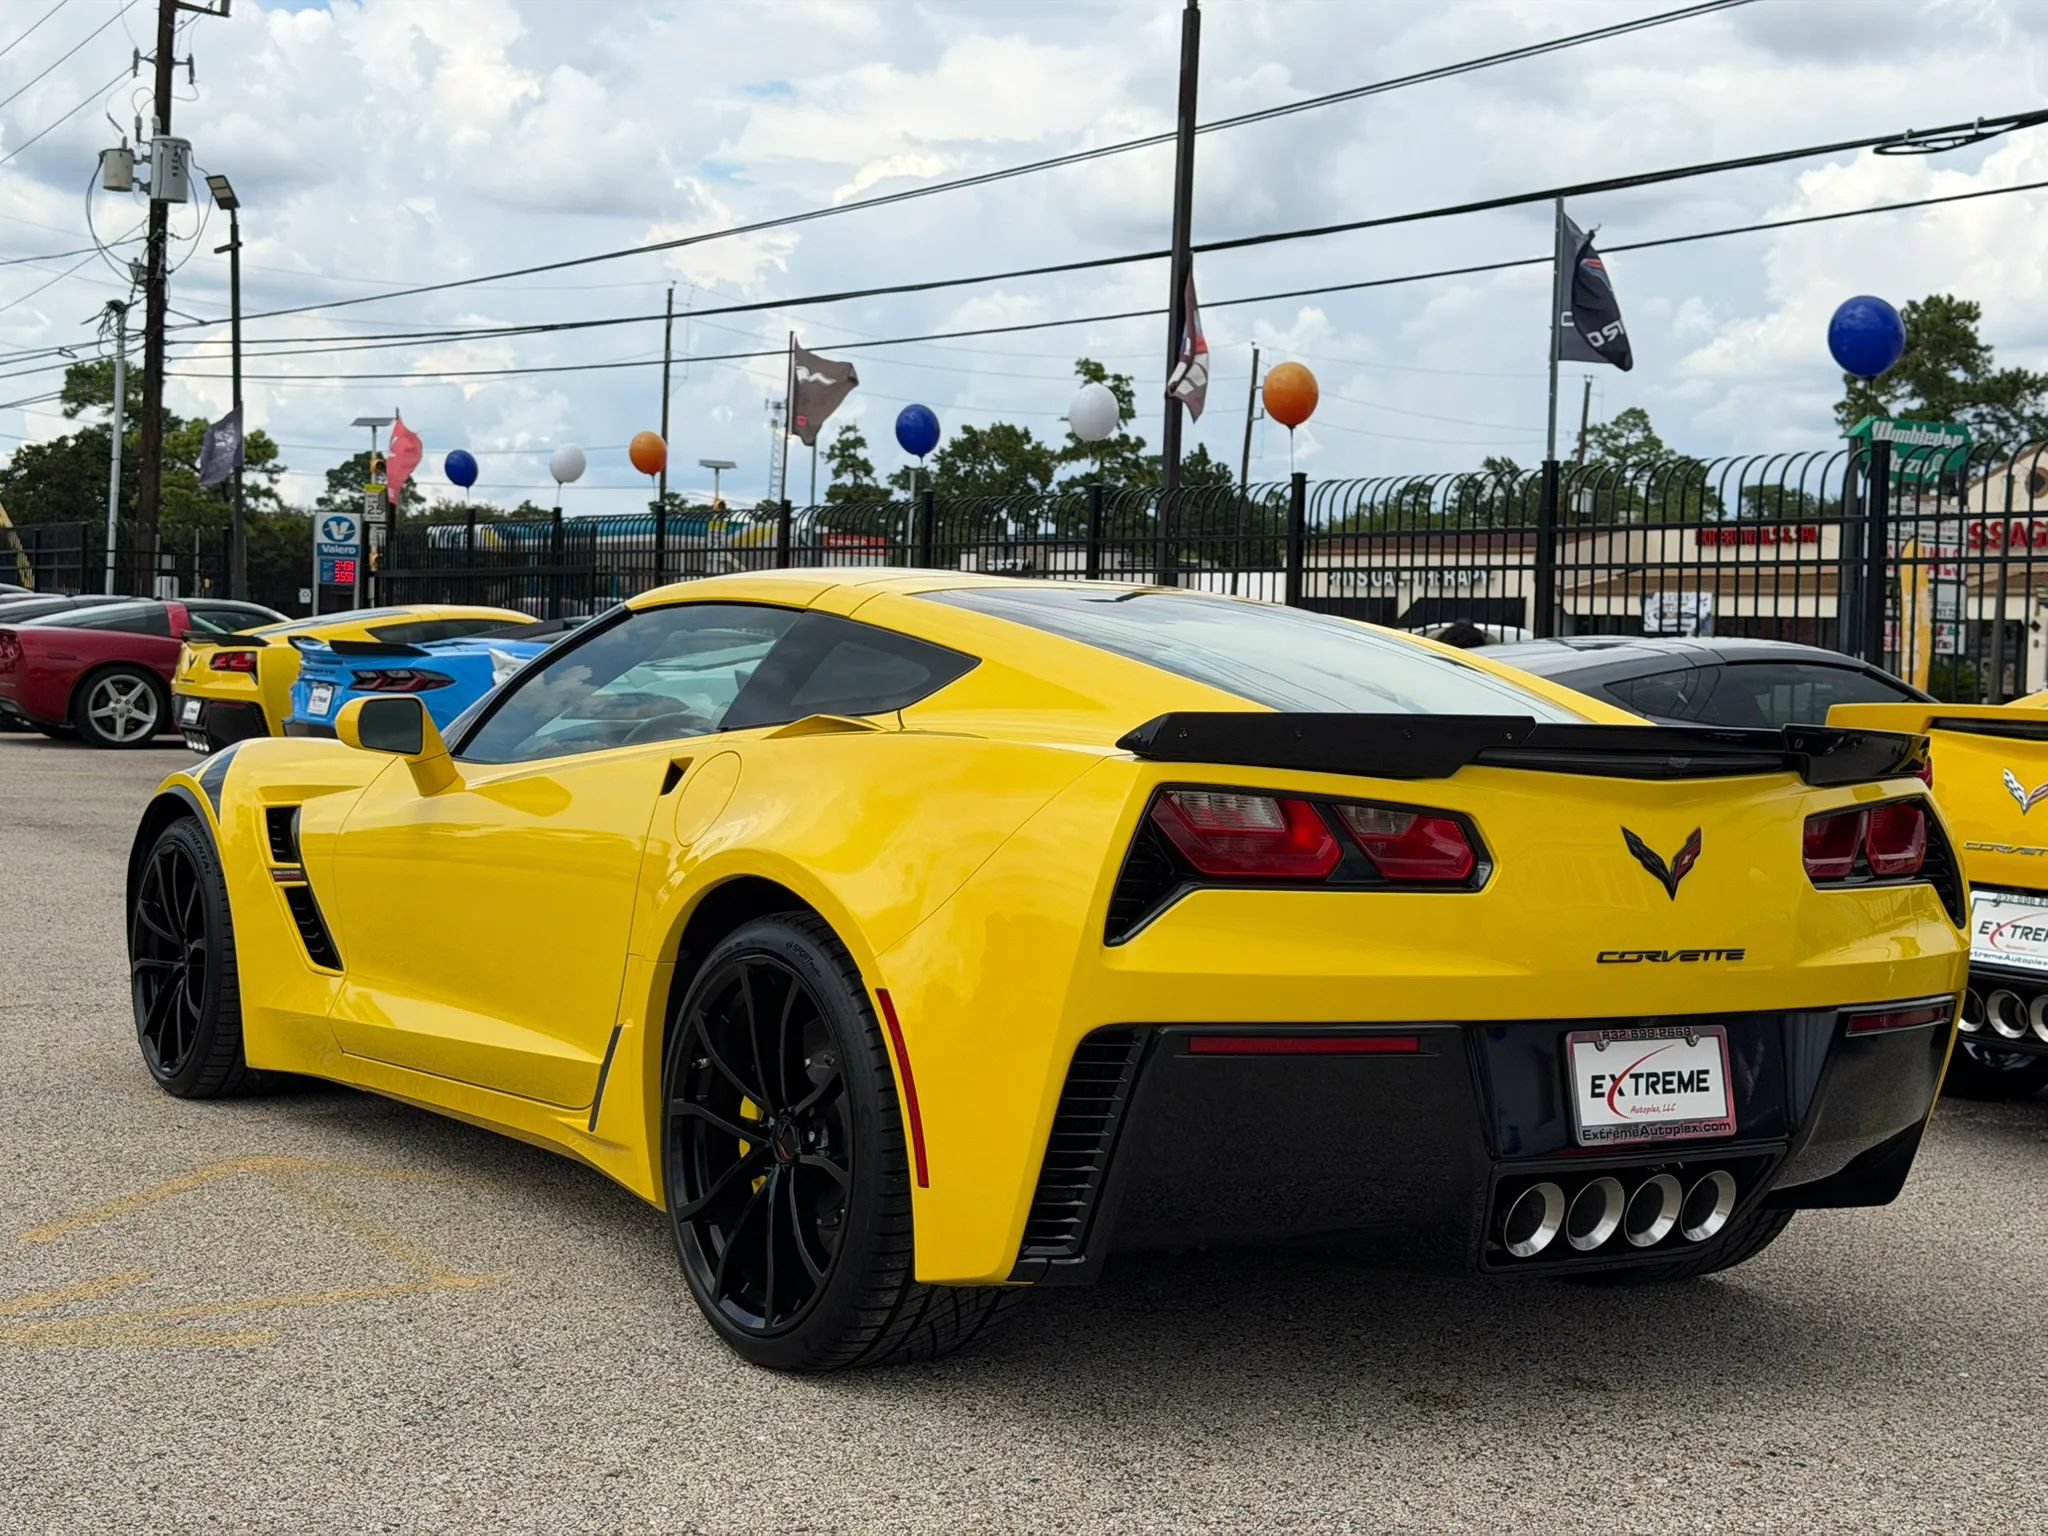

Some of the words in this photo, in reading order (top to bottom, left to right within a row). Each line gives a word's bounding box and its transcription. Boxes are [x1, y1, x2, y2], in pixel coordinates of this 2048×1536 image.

[367, 504, 384, 515] 25
[321, 544, 356, 554] Valero
[1596, 948, 1746, 963] CORVETTE
[1590, 1069, 1710, 1099] EXTREME
[1662, 1103, 1677, 1112] LLC
[1581, 1121, 1731, 1141] ExtremeAutoplex.com
